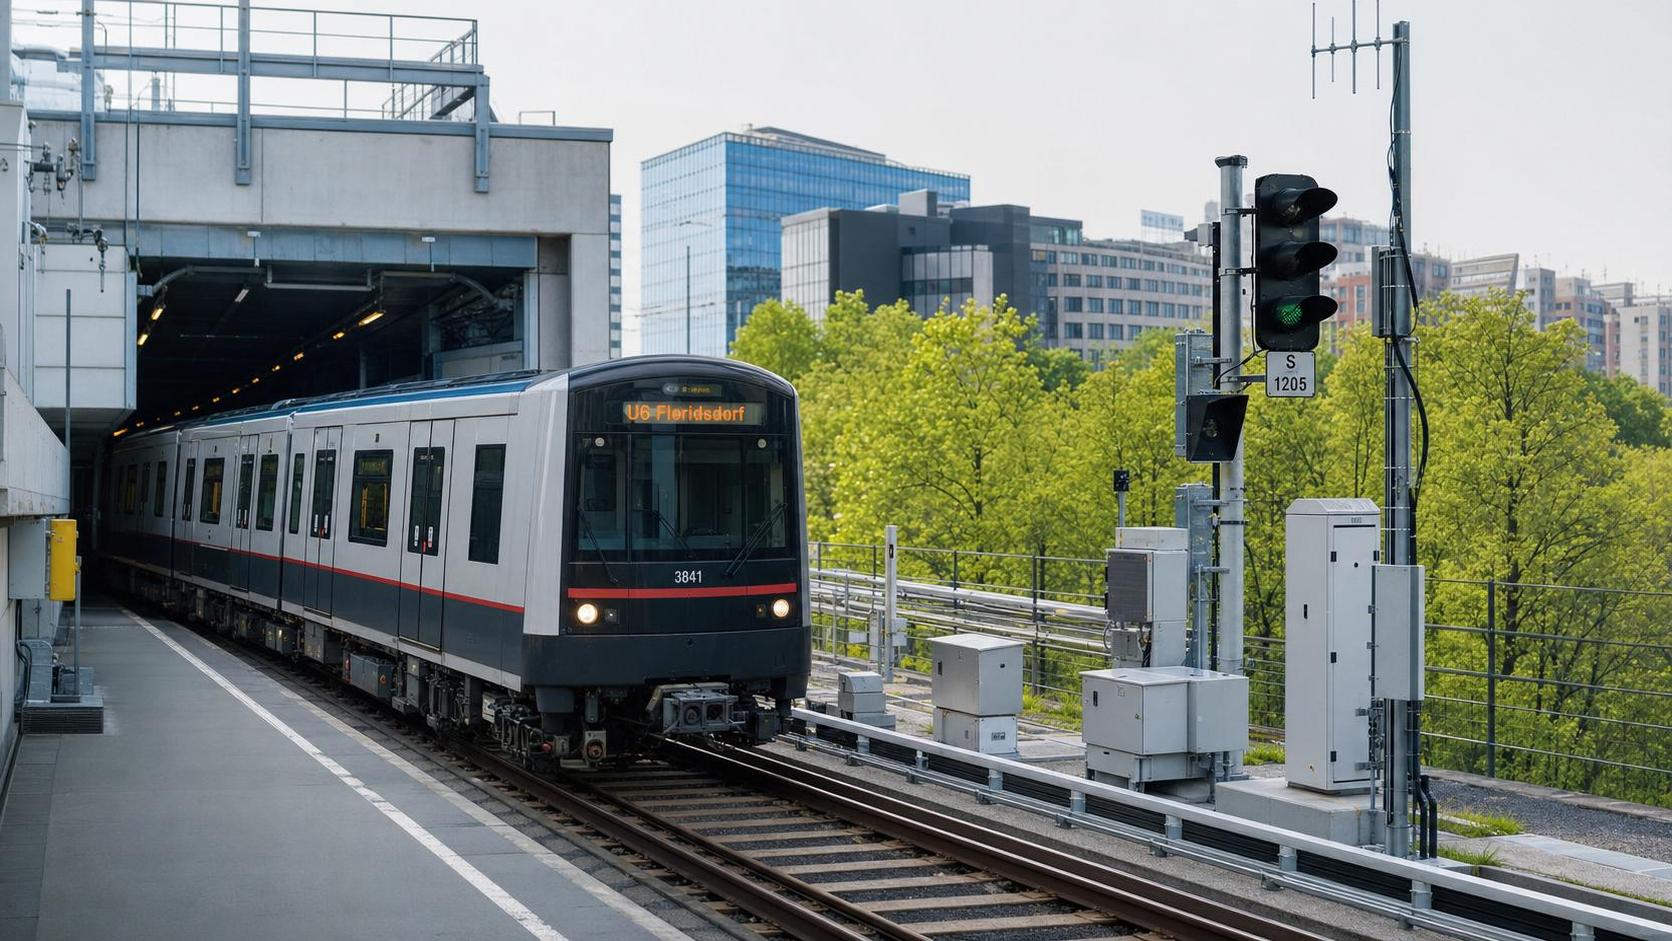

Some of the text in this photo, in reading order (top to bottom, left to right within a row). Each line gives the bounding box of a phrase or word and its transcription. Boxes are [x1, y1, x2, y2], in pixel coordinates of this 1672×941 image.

[1286, 354, 1296, 369] S
[1274, 376, 1307, 391] 1205
[626, 404, 745, 421] U6 Floridsdorf
[674, 570, 702, 583] 3841
